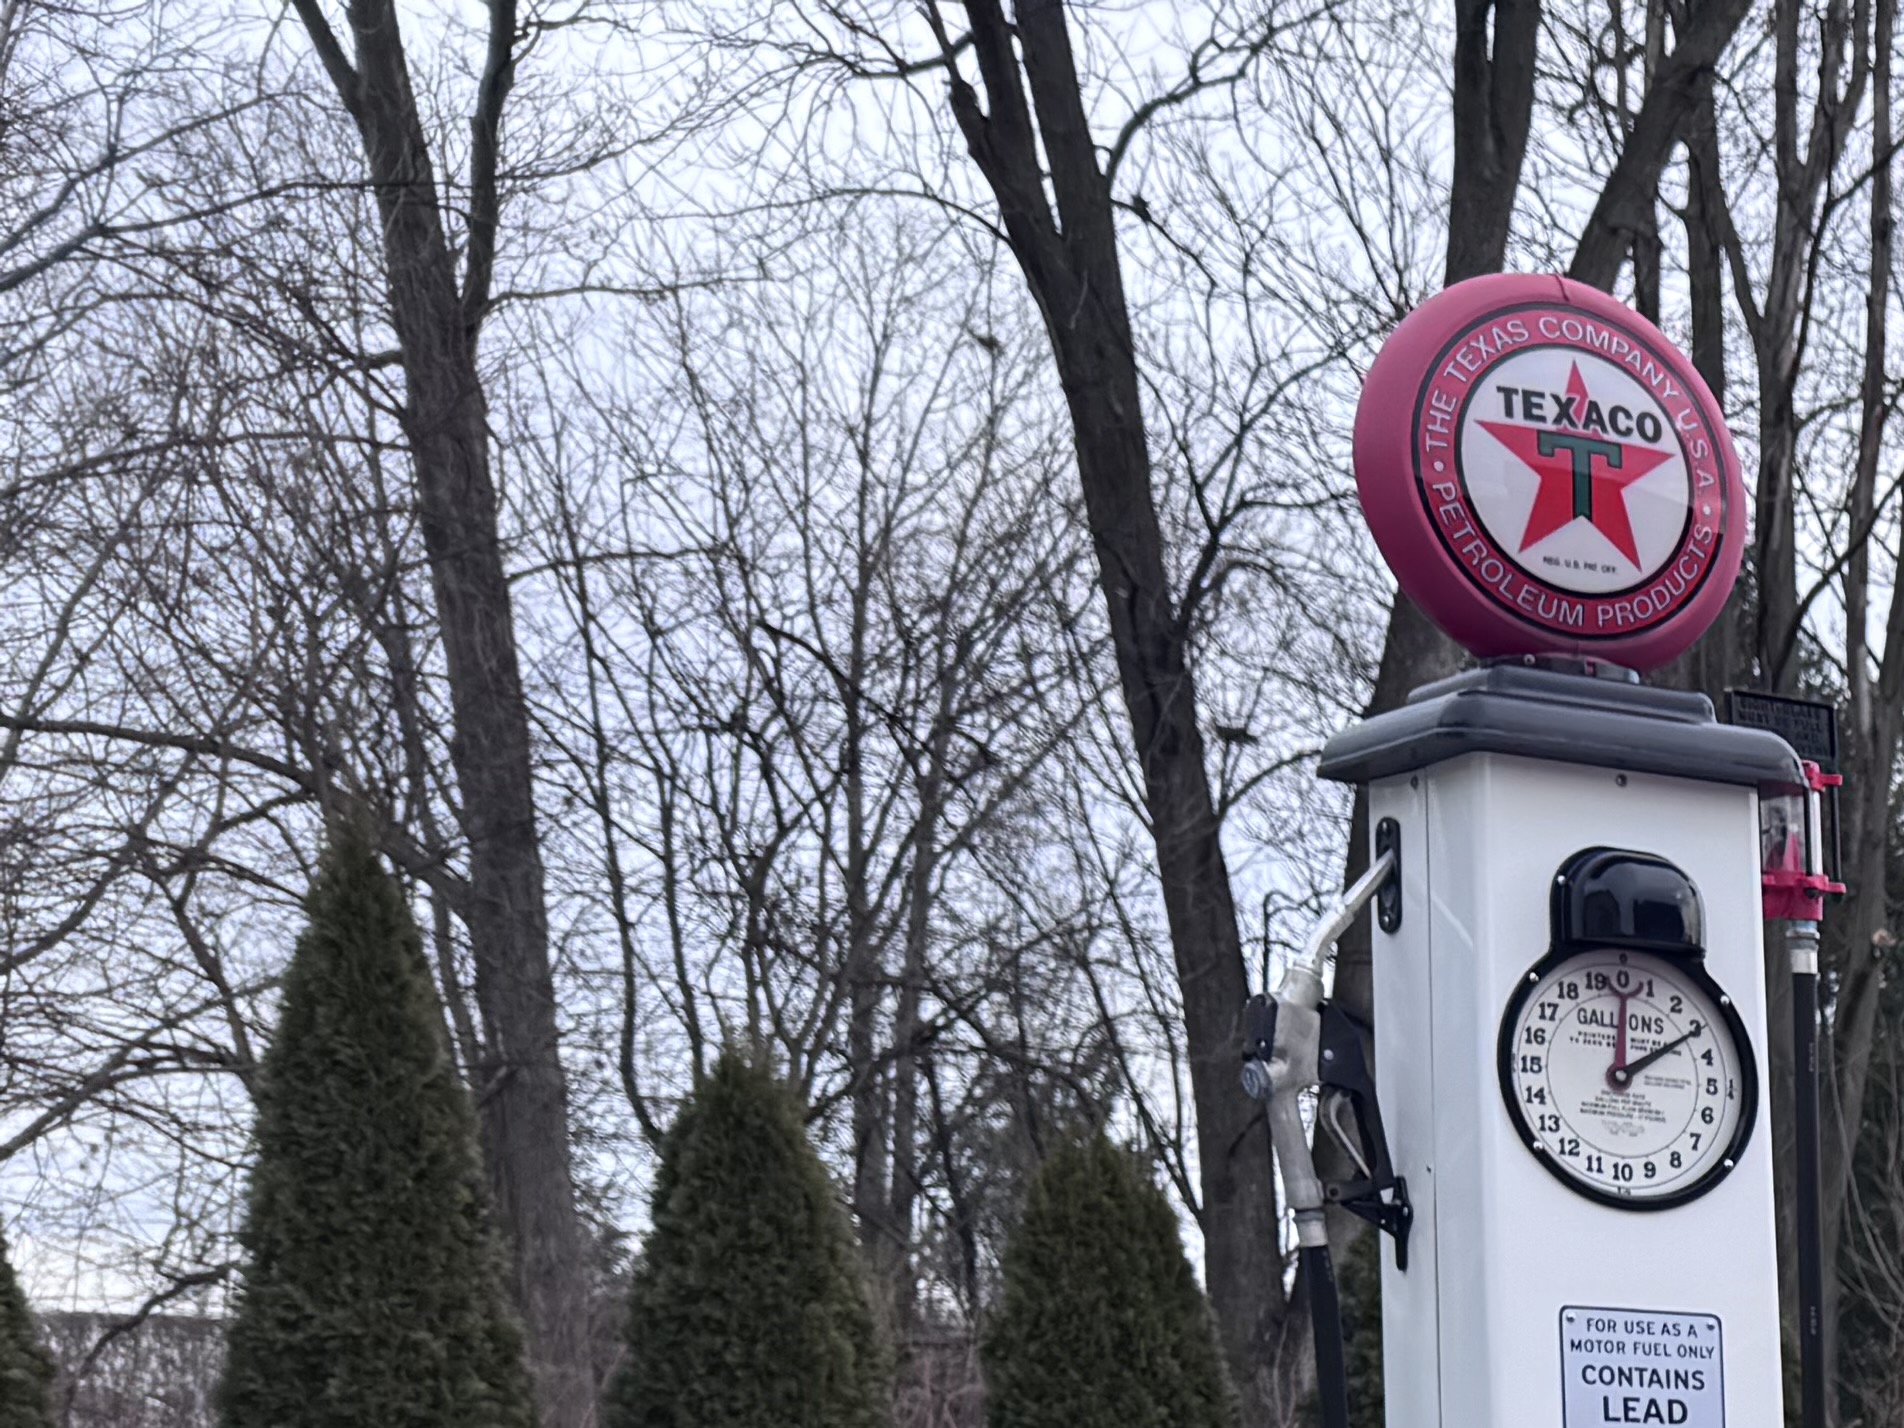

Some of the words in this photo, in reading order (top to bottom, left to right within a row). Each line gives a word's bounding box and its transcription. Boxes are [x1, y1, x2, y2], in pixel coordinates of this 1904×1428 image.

[1426, 389, 1457, 453] THE
[1443, 319, 1529, 382] TEXAS
[1538, 316, 1679, 399] COMPANY
[1495, 385, 1663, 443] TEXACO
[1536, 430, 1623, 521] T
[1432, 481, 1584, 627] PETROLEUM
[1597, 524, 1713, 627] PRODUCTS
[1585, 971, 1607, 991] 19
[1617, 970, 1630, 988] 0
[1646, 979, 1654, 998] 1
[1558, 981, 1579, 1000] 18
[1539, 1002, 1559, 1021] 17
[1670, 996, 1683, 1014] 2
[1577, 1008, 1665, 1035] GALLONS
[1689, 1020, 1701, 1038] 3
[1525, 1026, 1546, 1045] 16
[1521, 1055, 1542, 1074] 15
[1701, 1048, 1713, 1066] 4
[1525, 1085, 1546, 1105] 14
[1706, 1077, 1718, 1096] 5
[1539, 1114, 1560, 1133] 13
[1701, 1106, 1714, 1124] 6
[1559, 1137, 1580, 1157] 12
[1690, 1132, 1701, 1151] 7
[1586, 1155, 1604, 1174] 11
[1669, 1151, 1682, 1169] 8
[1612, 1162, 1633, 1182] 10
[1644, 1161, 1656, 1179] 9
[1587, 1317, 1617, 1333] FOR
[1624, 1320, 1656, 1335] USE
[1661, 1322, 1681, 1337] AS
[1688, 1324, 1698, 1339] A
[1570, 1339, 1626, 1355] MOTOR
[1633, 1342, 1672, 1357] FUEL
[1677, 1344, 1715, 1359] ONLY
[1581, 1364, 1706, 1391] CONTAINS
[1603, 1395, 1688, 1425] LEAD
